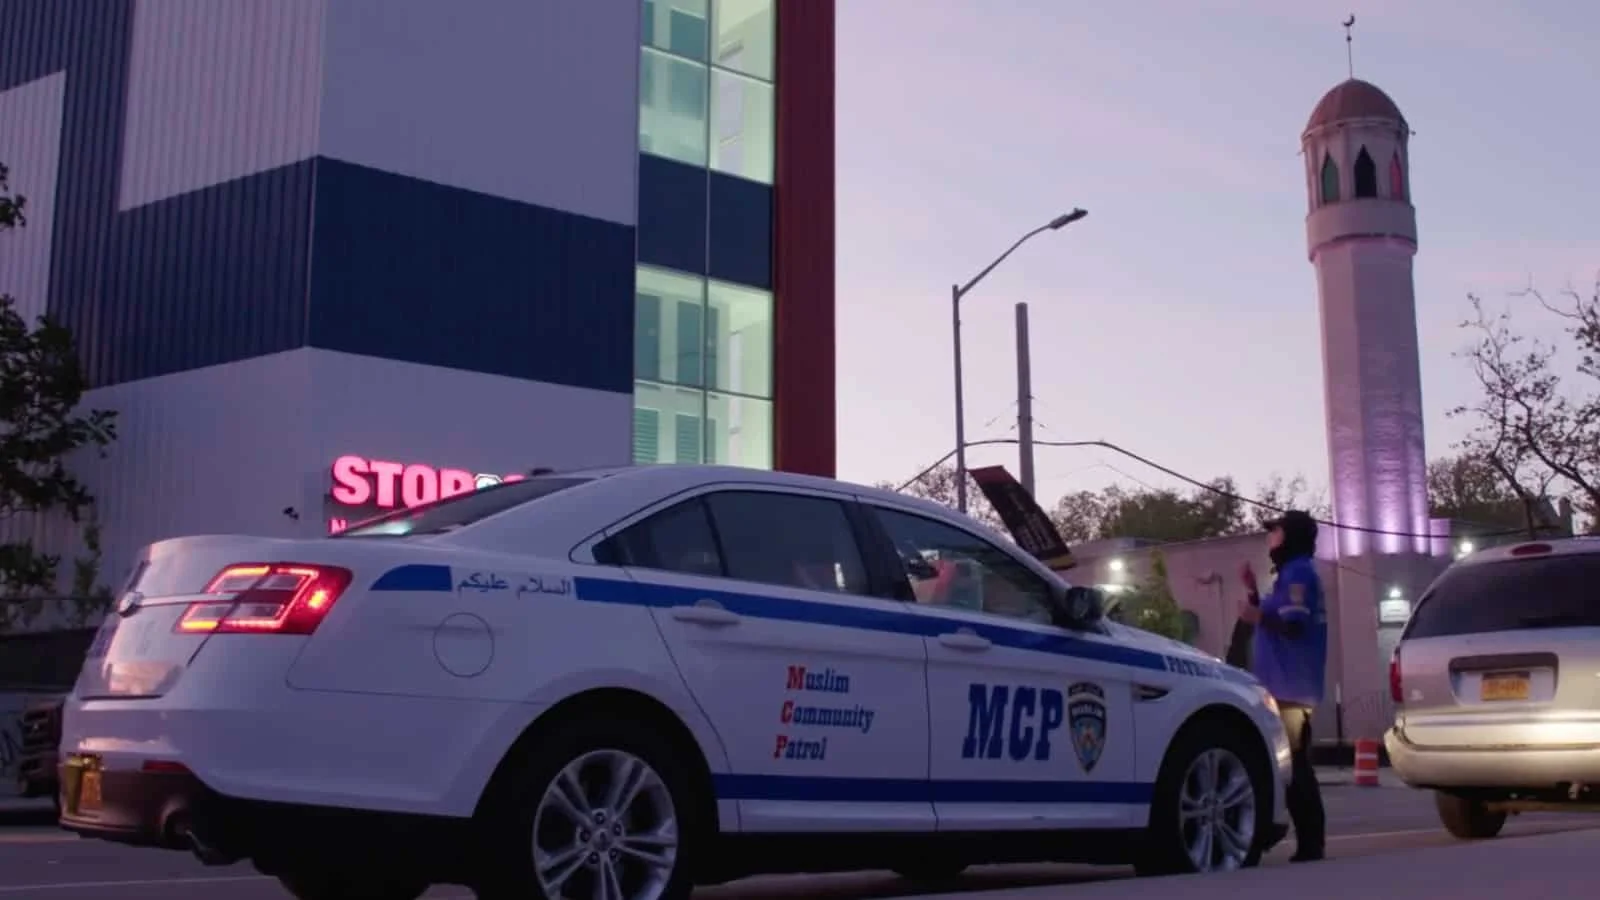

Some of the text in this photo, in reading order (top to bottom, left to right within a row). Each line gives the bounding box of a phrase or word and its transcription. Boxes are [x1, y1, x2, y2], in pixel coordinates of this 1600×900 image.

[457, 571, 571, 600] السلام عليكم
[786, 665, 850, 694] Muslim
[780, 701, 875, 734] Community
[962, 683, 1064, 762] MCP
[773, 735, 828, 760] Patrol
